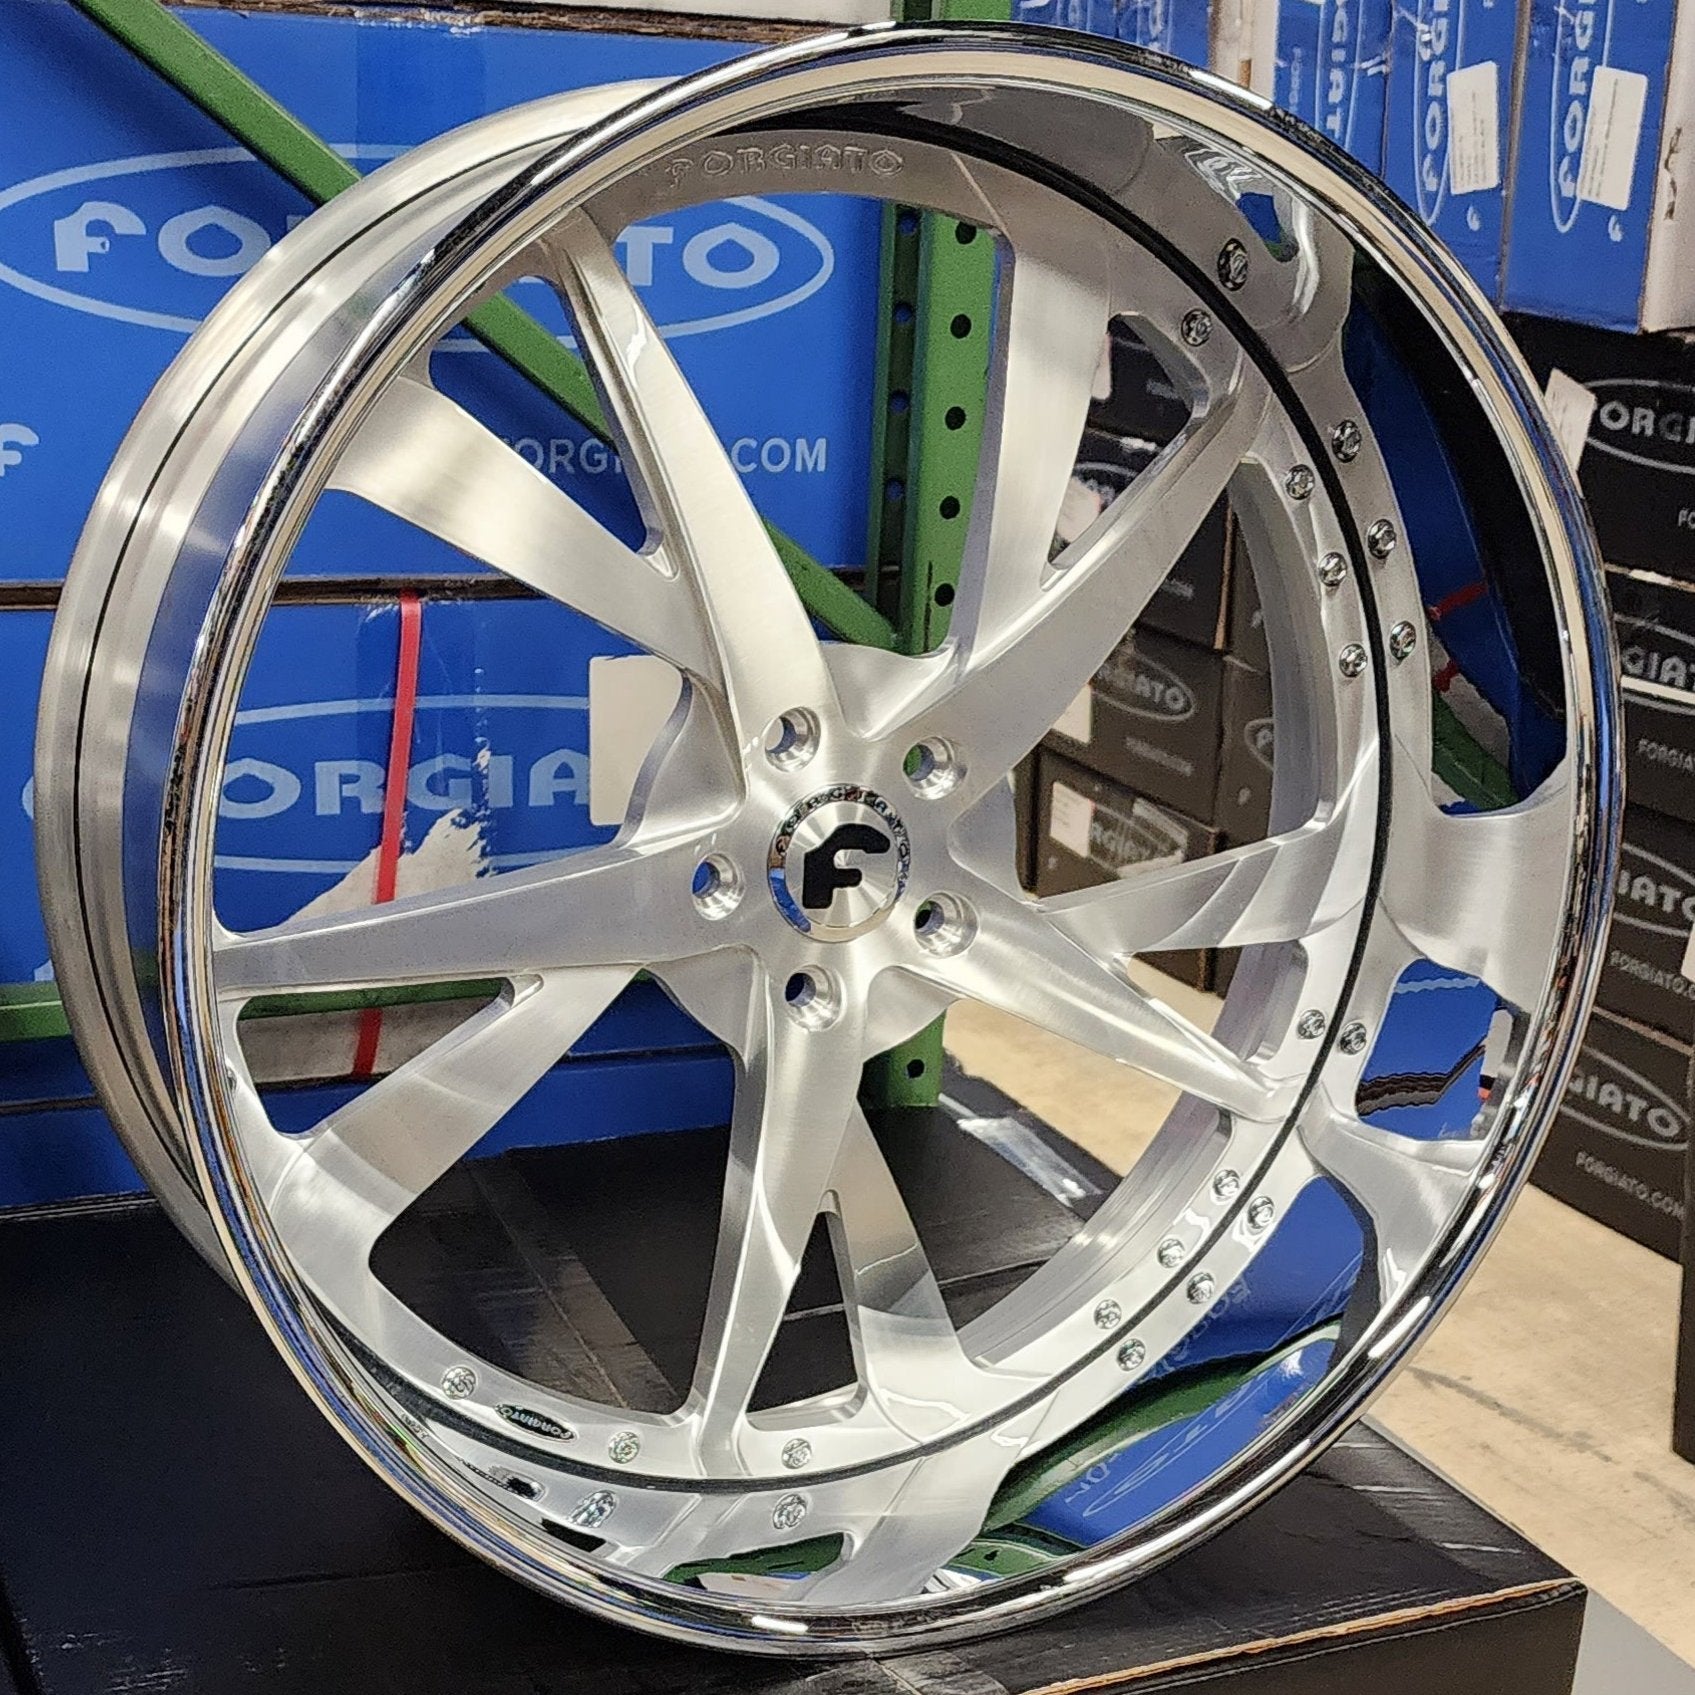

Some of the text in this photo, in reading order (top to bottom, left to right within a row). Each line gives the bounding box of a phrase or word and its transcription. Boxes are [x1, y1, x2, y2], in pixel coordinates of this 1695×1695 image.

[1558, 0, 1597, 198] FORG
[665, 143, 903, 187] FORGIATO
[1600, 400, 1695, 443] ORGI
[218, 748, 590, 820] ORGIA
[802, 823, 891, 909] F
